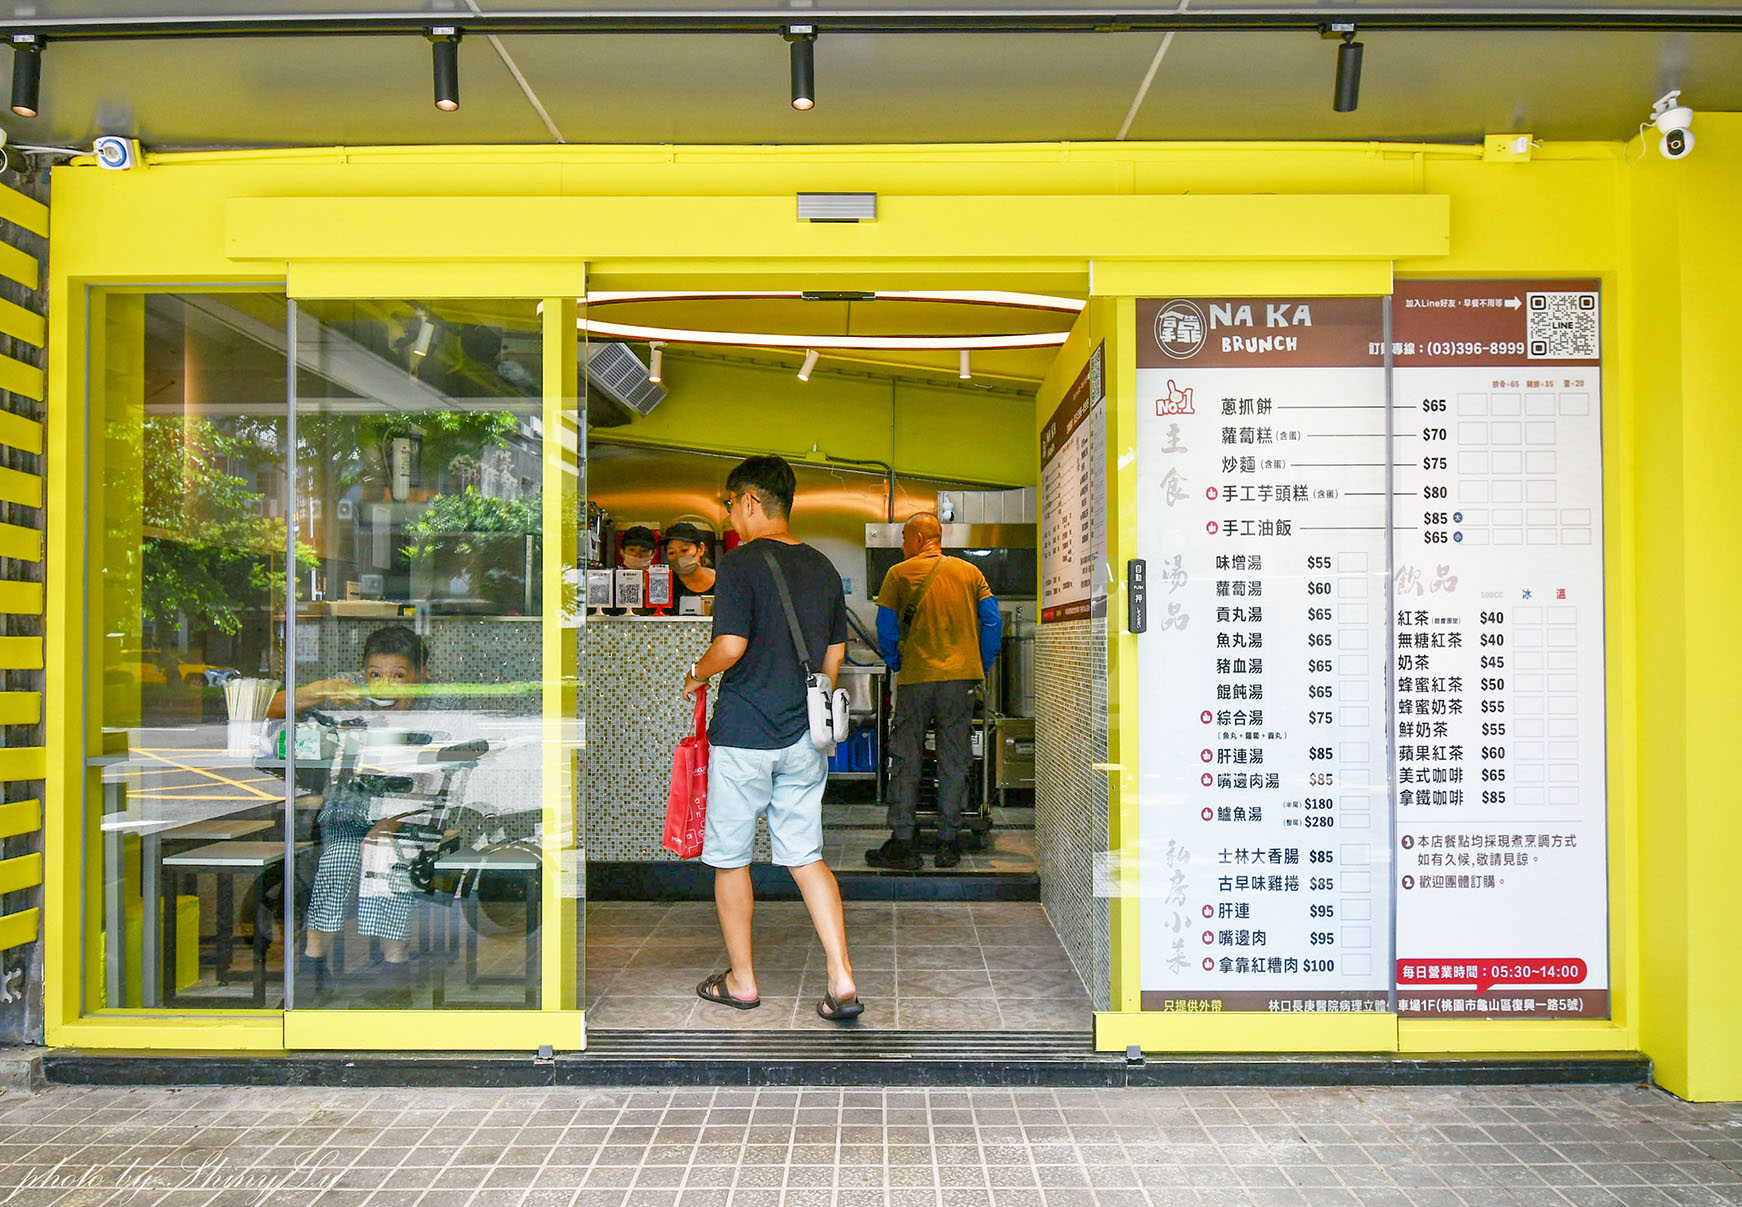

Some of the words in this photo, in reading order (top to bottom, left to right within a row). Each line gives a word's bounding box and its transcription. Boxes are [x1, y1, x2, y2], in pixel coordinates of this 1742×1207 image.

[1209, 303, 1254, 329] NA
[1266, 303, 1312, 328] KA
[1552, 321, 1573, 330] LINE
[1222, 335, 1297, 353] BRUNCH
[1368, 341, 1525, 356] 訂專線：(03)396-8999
[1221, 398, 1272, 415] 蔥抓餅
[1423, 399, 1446, 412] $65
[1222, 427, 1272, 444] 蘿蔔糕
[1276, 431, 1300, 440] (含蛋)
[1423, 428, 1446, 441] $70
[1261, 460, 1285, 469] (含蛋)
[1424, 457, 1447, 470] $75
[1223, 485, 1308, 502] 手工芋頭糕
[1313, 490, 1338, 499] (含蛋)
[1424, 486, 1447, 499] $80
[1223, 519, 1291, 536] 手工油飯
[1424, 512, 1447, 525] $85
[1424, 531, 1447, 544] $65
[1216, 555, 1261, 570] 味增湯
[1308, 556, 1331, 569] $55
[1216, 581, 1262, 597] 蘿蔔湯
[1308, 581, 1331, 595] $60
[1217, 606, 1262, 622] 貢丸湯
[1308, 607, 1331, 621] $65
[1398, 610, 1428, 626] 紅茶
[1480, 611, 1503, 624] $40
[1217, 632, 1262, 648] 魚丸湯
[1308, 633, 1332, 647] $65
[1398, 632, 1462, 648] 無糖紅茶
[1481, 633, 1504, 647] $40
[1217, 658, 1262, 674] 豬血湯
[1309, 659, 1332, 673] $65
[1398, 654, 1429, 670] 奶茶
[1481, 656, 1504, 669] $45
[1217, 684, 1262, 699] 餛飩湯
[1309, 685, 1332, 699] $65
[1399, 677, 1462, 693] 蜂蜜紅茶
[1481, 678, 1504, 691] $50
[1399, 699, 1462, 715] 蜂蜜奶茶
[1481, 700, 1504, 713] $55
[1217, 710, 1263, 725] 綜合湯
[1309, 711, 1332, 725] $75
[1399, 721, 1447, 738] 鮮奶茶
[1482, 722, 1505, 736] $55
[1217, 748, 1263, 764] 肝連湯
[1309, 746, 1333, 760] $85
[1399, 745, 1463, 761] 蘋果紅茶
[1482, 746, 1505, 759] $60
[1218, 773, 1279, 789] 嘴邊肉湯
[1310, 772, 1333, 786] $85
[1400, 767, 1463, 783] 美式咖啡
[1482, 768, 1505, 782] $65
[1305, 798, 1332, 810] $180
[1400, 789, 1463, 806] 拿鐵咖啡
[1482, 790, 1505, 804] $85
[1218, 806, 1262, 821] 鱸魚湯
[1305, 816, 1334, 828] $280
[1418, 834, 1576, 848] 本店餐點均採現煮烹調方式
[1219, 848, 1299, 864] 士林大香腸
[1310, 850, 1333, 864] $85
[1218, 875, 1299, 891] 古早味雞捲
[1310, 877, 1333, 891] $85
[1219, 902, 1249, 919] 肝連
[1310, 904, 1333, 918] $95
[1219, 929, 1266, 946] 嘴邊肉
[1310, 931, 1334, 945] $95
[1219, 957, 1297, 973] 拿靠紅糟肉
[1303, 959, 1334, 972] $100
